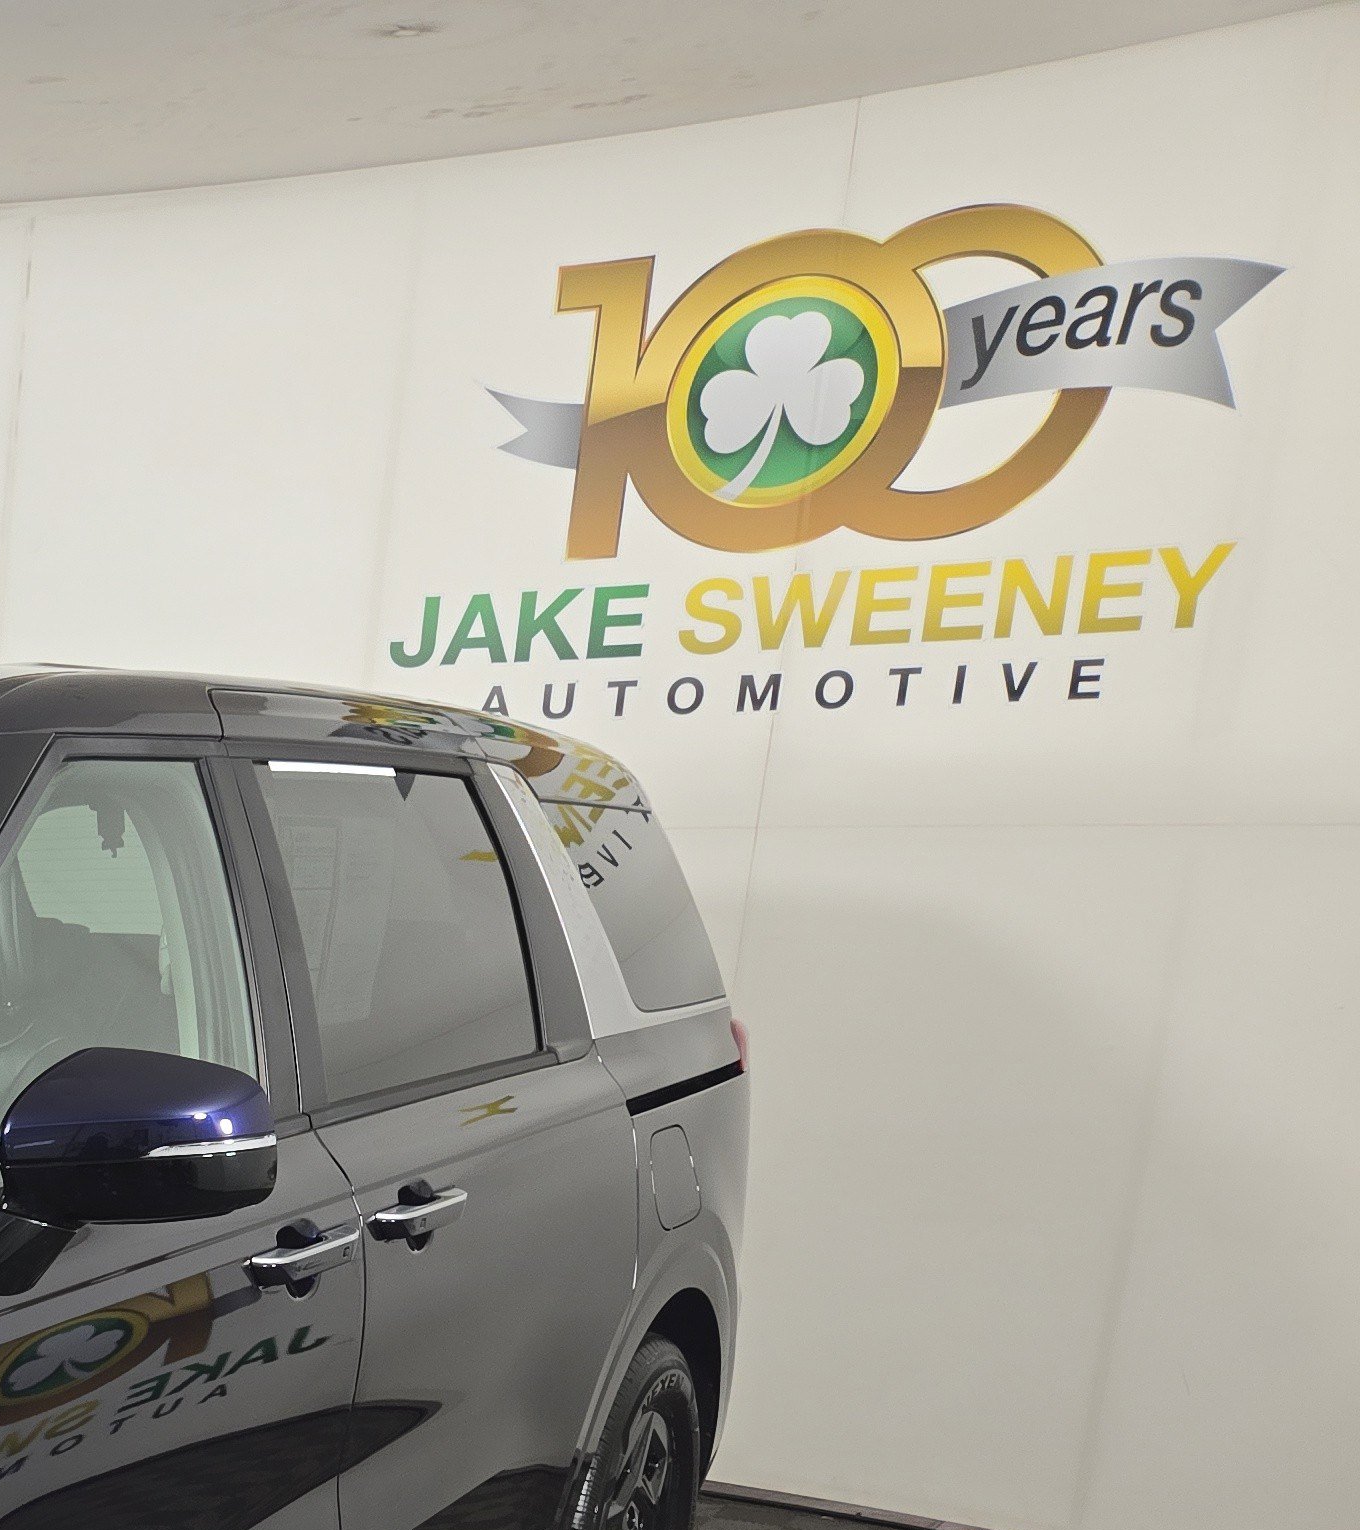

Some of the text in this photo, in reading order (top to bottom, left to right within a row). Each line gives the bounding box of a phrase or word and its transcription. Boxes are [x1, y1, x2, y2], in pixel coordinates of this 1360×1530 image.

[960, 275, 1205, 390] years
[389, 541, 1237, 669] JAKE SWEENEY
[481, 657, 1106, 719] AUTOMOTIVE
